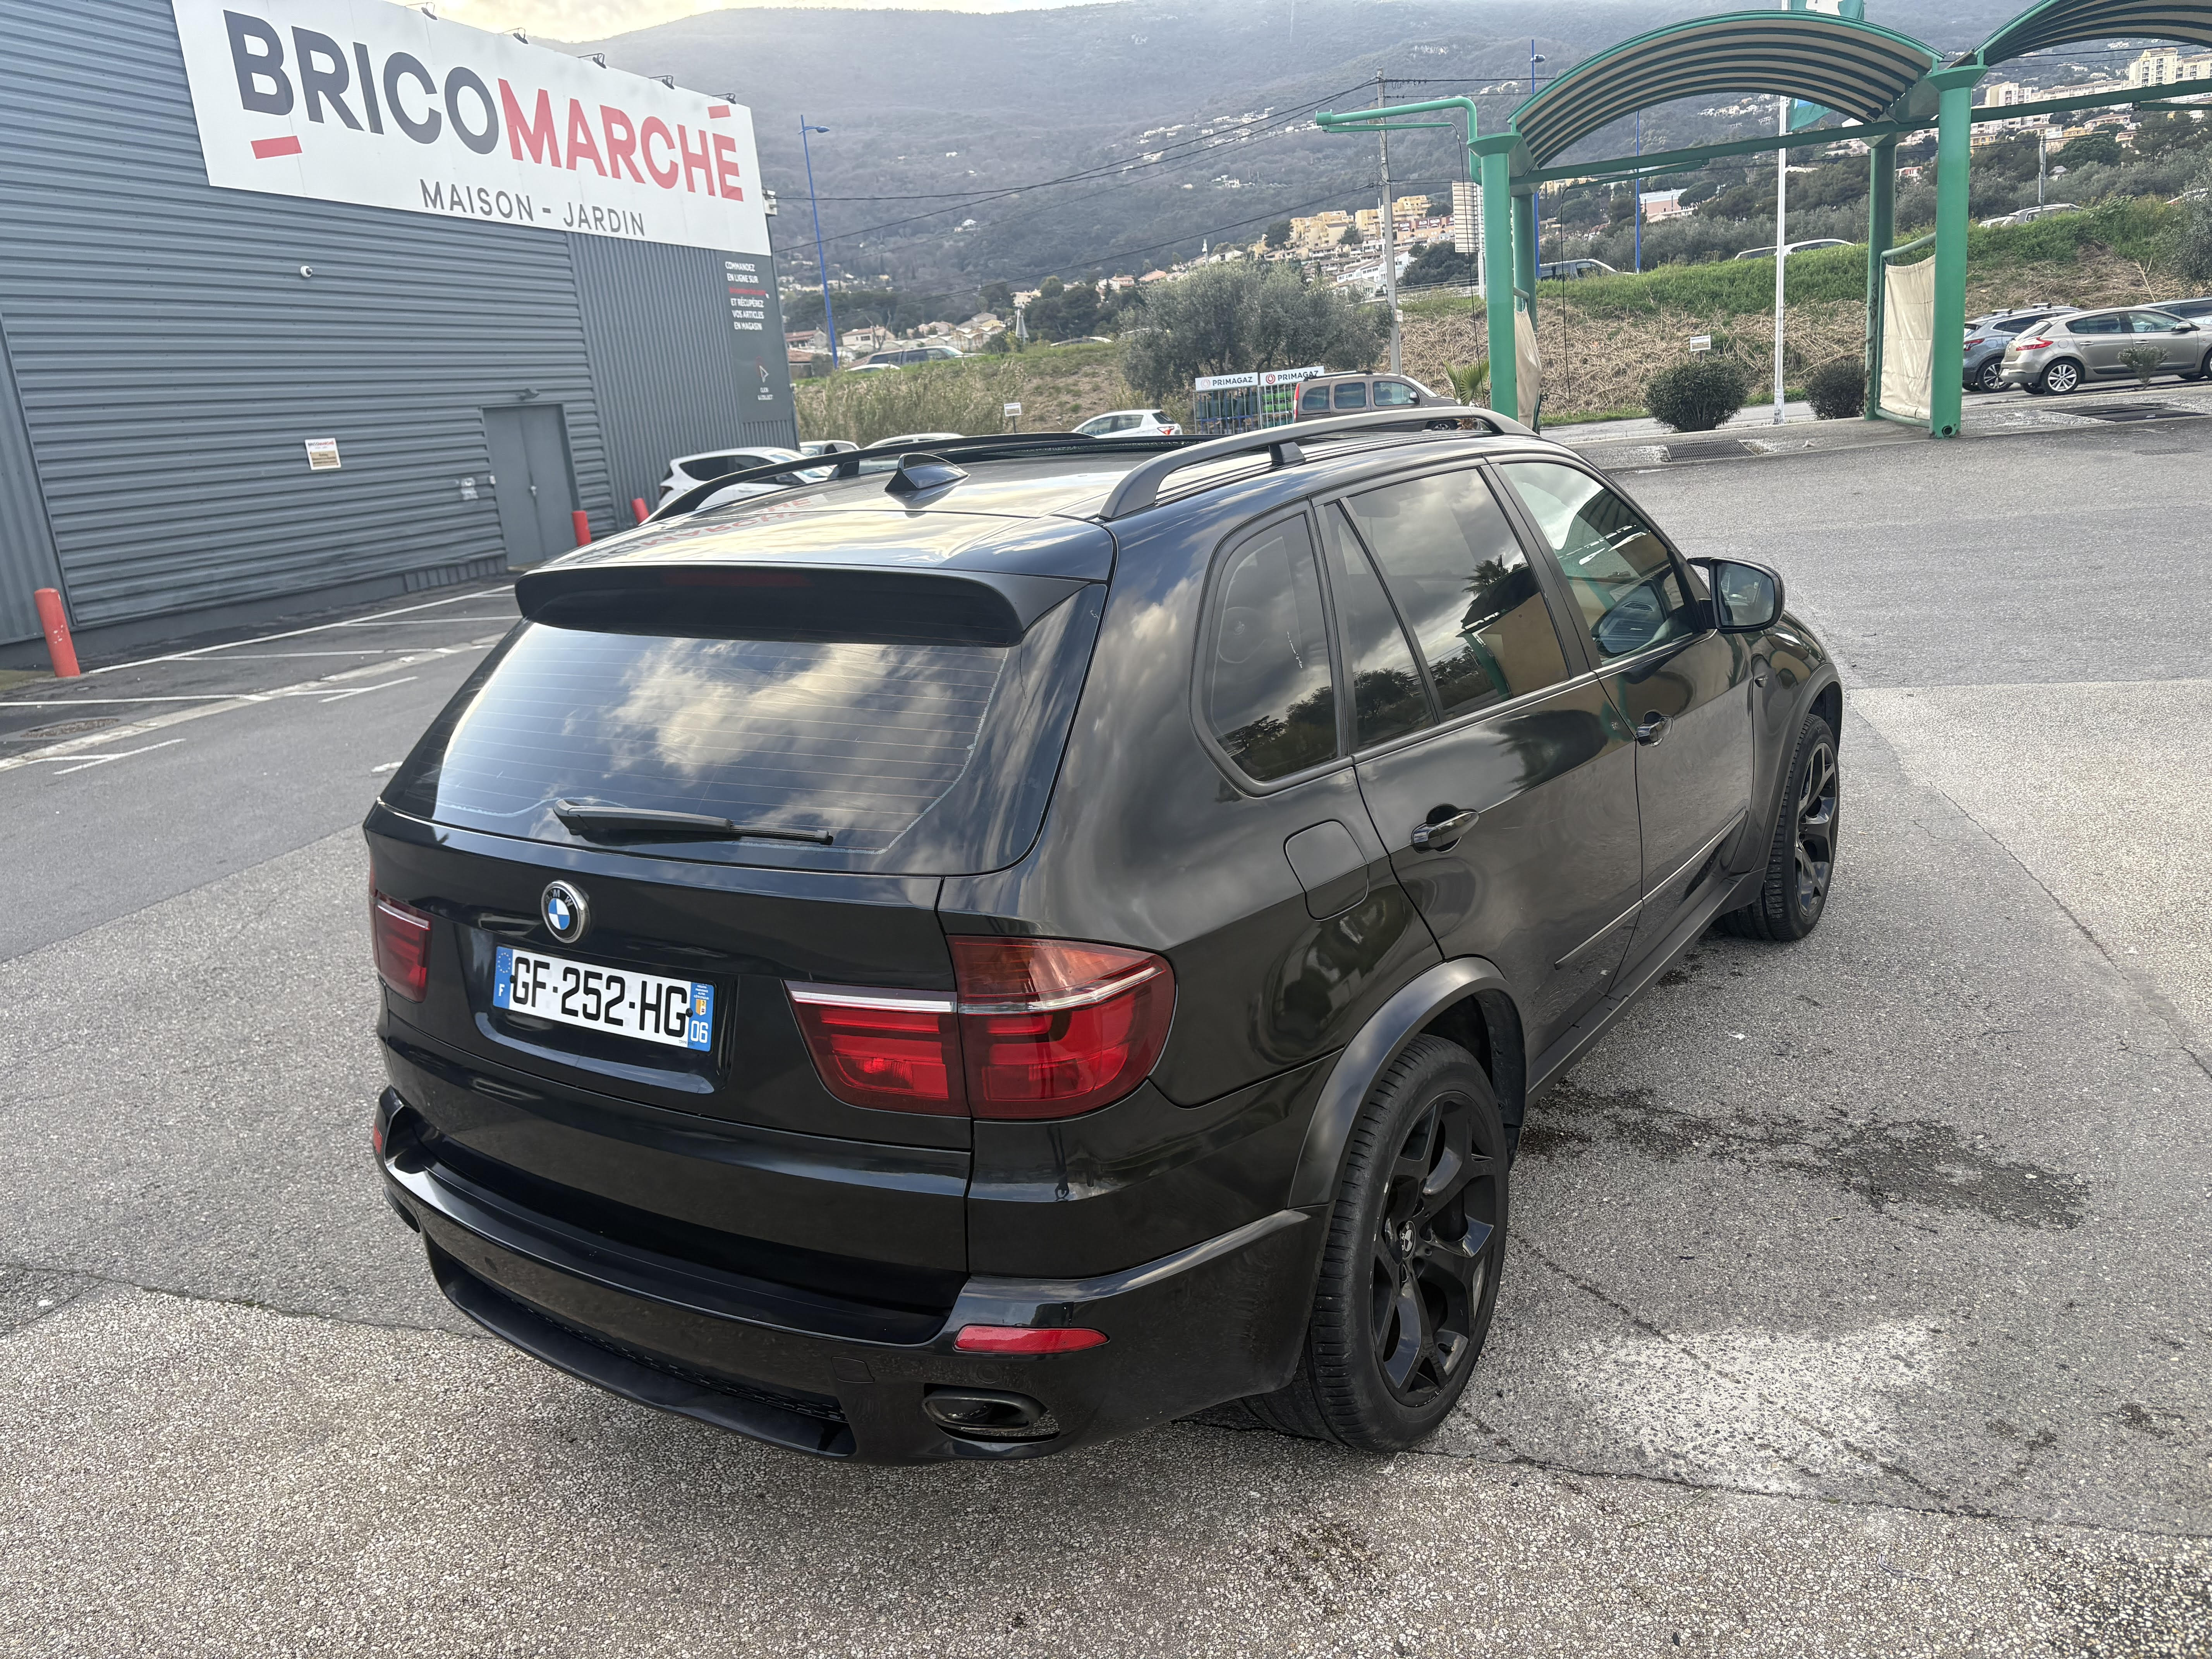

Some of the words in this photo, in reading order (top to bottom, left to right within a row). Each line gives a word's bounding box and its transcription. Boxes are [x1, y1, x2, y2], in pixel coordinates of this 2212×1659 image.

[223, 10, 744, 202] BRICOMARCHÉ
[420, 179, 534, 221] MAISON
[563, 202, 645, 236] JARDIN
[1212, 376, 1253, 386] PRIMAGAZ
[545, 889, 574, 907] BMW
[498, 984, 505, 996] F
[512, 957, 687, 1037] GF-252-HG
[690, 1020, 709, 1043] 06
